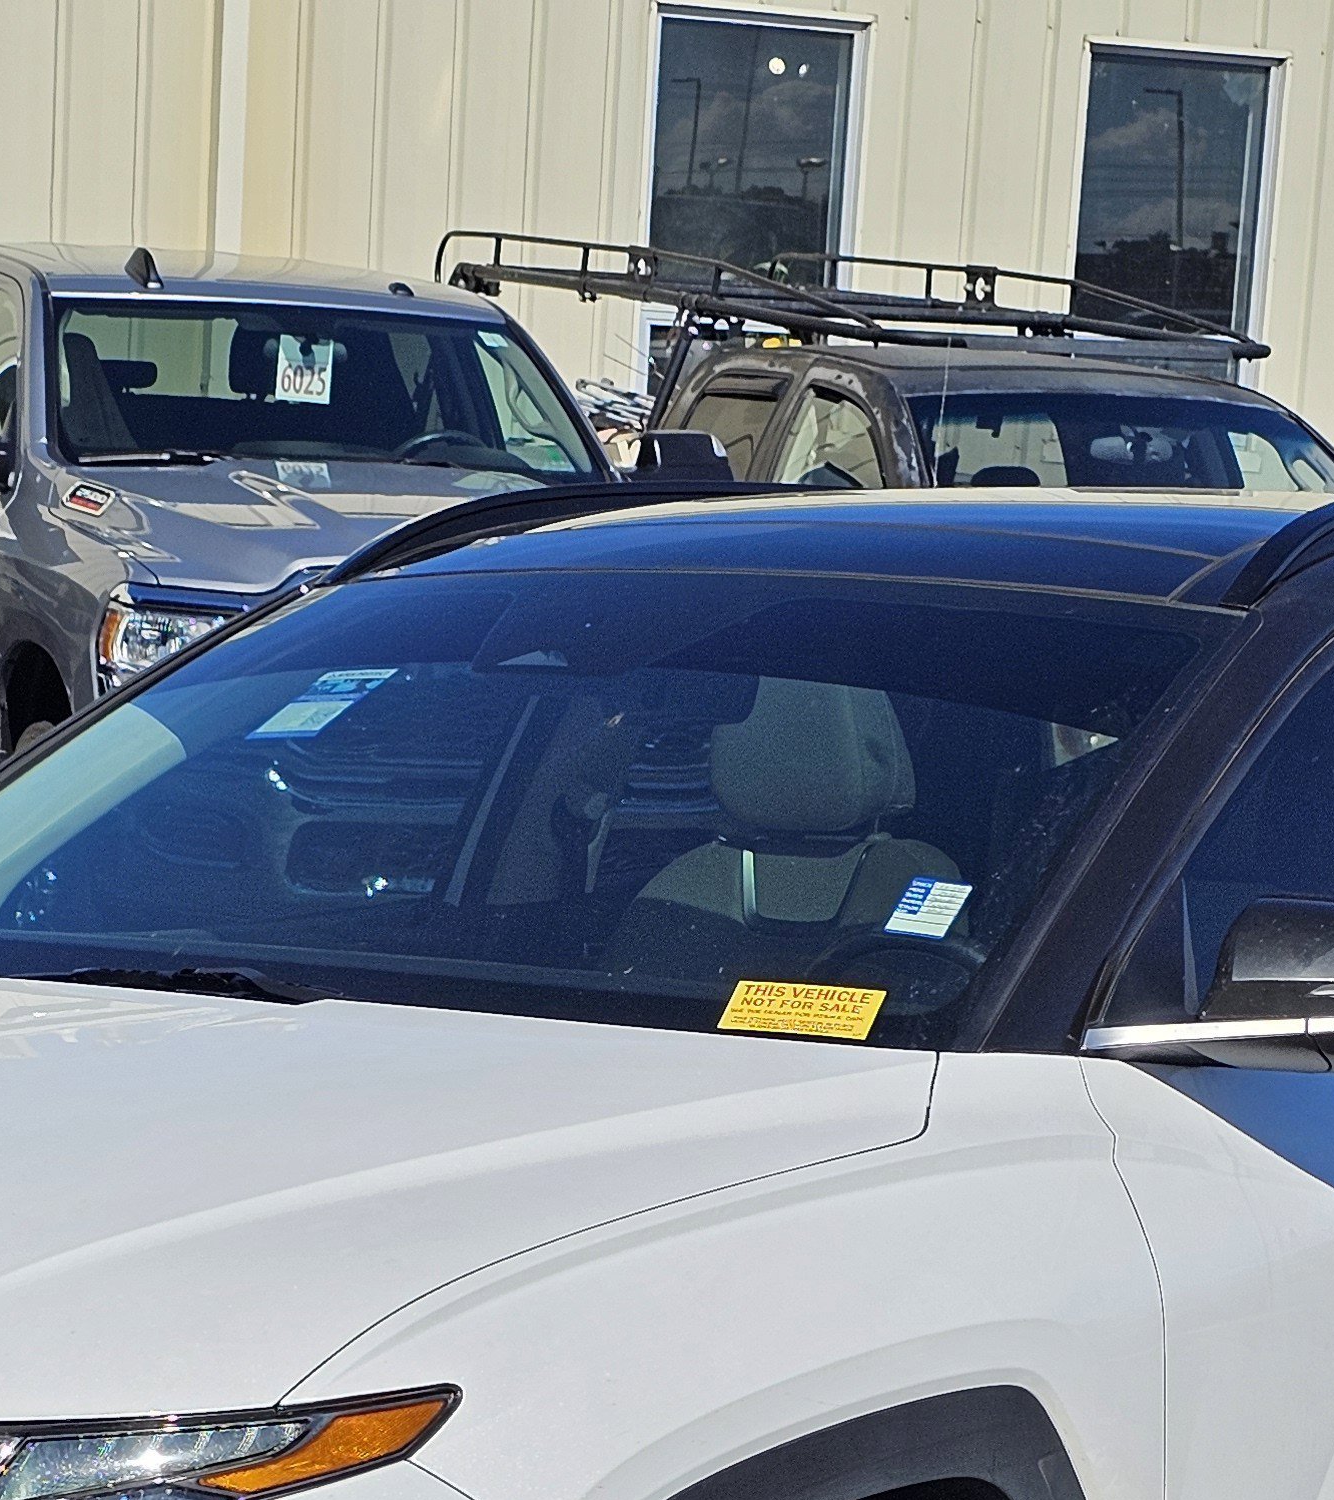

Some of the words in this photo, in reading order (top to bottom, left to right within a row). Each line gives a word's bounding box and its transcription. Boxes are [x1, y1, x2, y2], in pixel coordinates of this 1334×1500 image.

[281, 363, 327, 396] 6025
[744, 984, 786, 997] THIS
[792, 987, 874, 1004] VEHICLE
[740, 997, 774, 1008] NOT
[779, 999, 812, 1010] FOR
[818, 1002, 863, 1014] SALE
